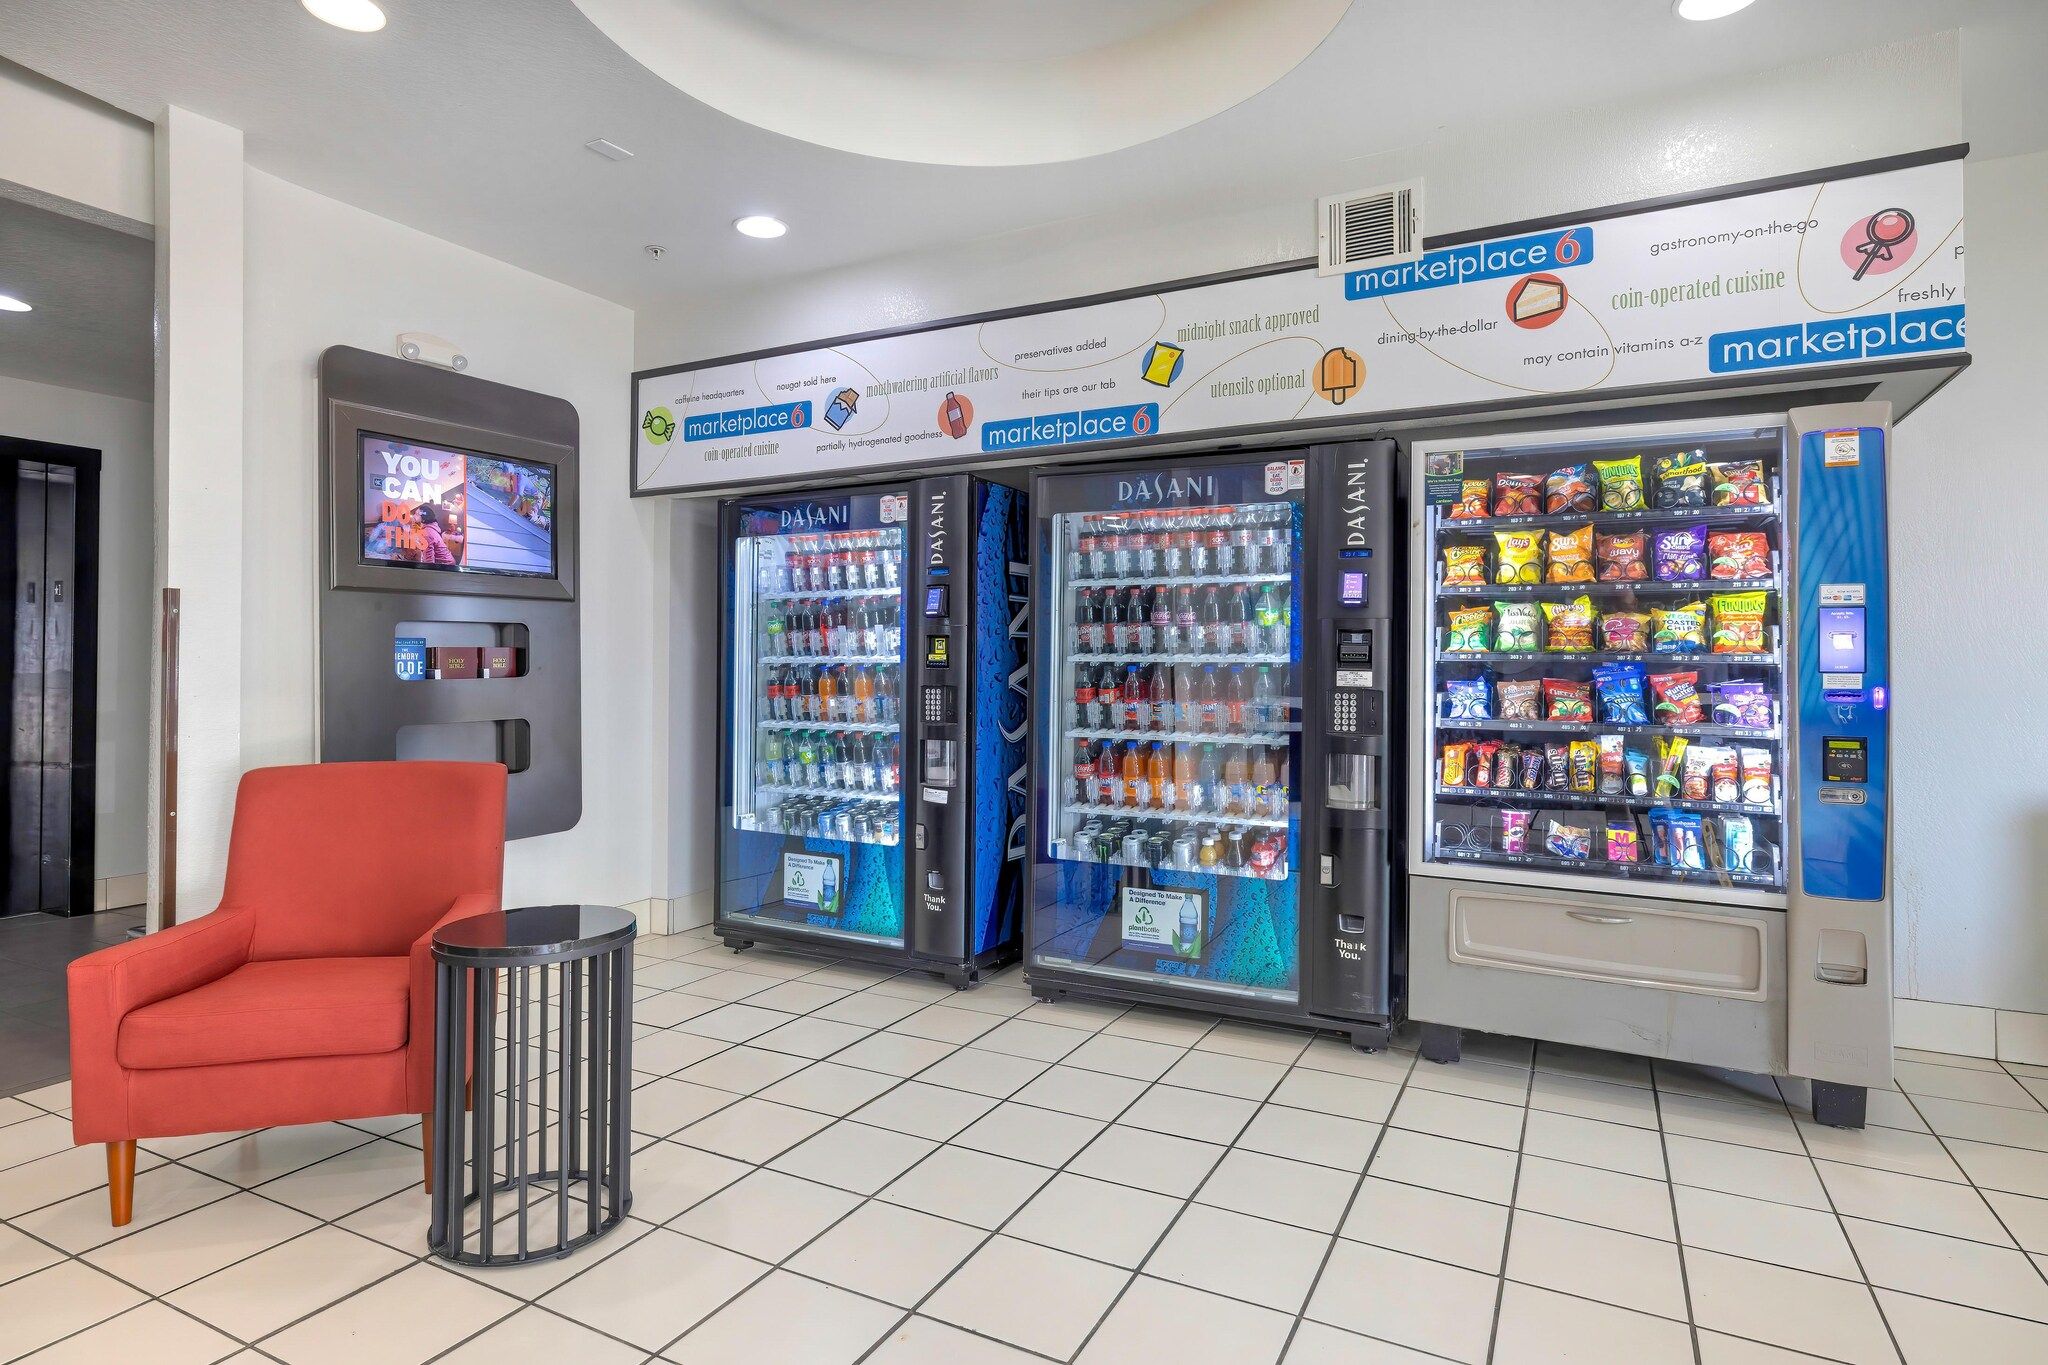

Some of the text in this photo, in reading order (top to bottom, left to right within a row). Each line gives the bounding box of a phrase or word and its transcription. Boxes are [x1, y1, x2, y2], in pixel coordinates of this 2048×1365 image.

[1650, 217, 1819, 256] gastronomy-on-the-go
[1355, 229, 1581, 292] marketplace 6
[1612, 269, 1786, 312] coin-operated cuisine
[1897, 284, 1957, 303] freshly
[1176, 305, 1320, 343] midnight snack approved
[1377, 319, 1498, 346] dining-by-the-dollar
[1014, 338, 1107, 362] preservatives added
[1523, 335, 1704, 367] may contain vitamins a-z
[776, 375, 837, 391] nougat sold here
[866, 365, 999, 398] mouthwatering artificial flavors
[1021, 379, 1116, 400] their tips are our tab
[1210, 367, 1306, 399] utensils optional
[674, 388, 745, 405] caffeine headquarters
[688, 404, 805, 437] marketplace 6
[988, 405, 1151, 446] marketplace 6
[703, 441, 780, 462] coin-operated cuisine
[816, 430, 943, 453] partially hydrogenated goodness
[381, 451, 440, 480] YOU
[381, 477, 441, 505] CAN
[1118, 473, 1213, 504] DASANI
[381, 500, 411, 524] DO
[781, 503, 847, 529] DASANI
[1342, 462, 1371, 545] DASANI
[384, 525, 429, 550] THIS
[928, 495, 947, 564] DASANI
[924, 893, 946, 904] Thank
[1129, 889, 1156, 898] Designed
[1135, 897, 1166, 906] Difference
[926, 902, 942, 912] You.
[1338, 949, 1361, 960] You.
